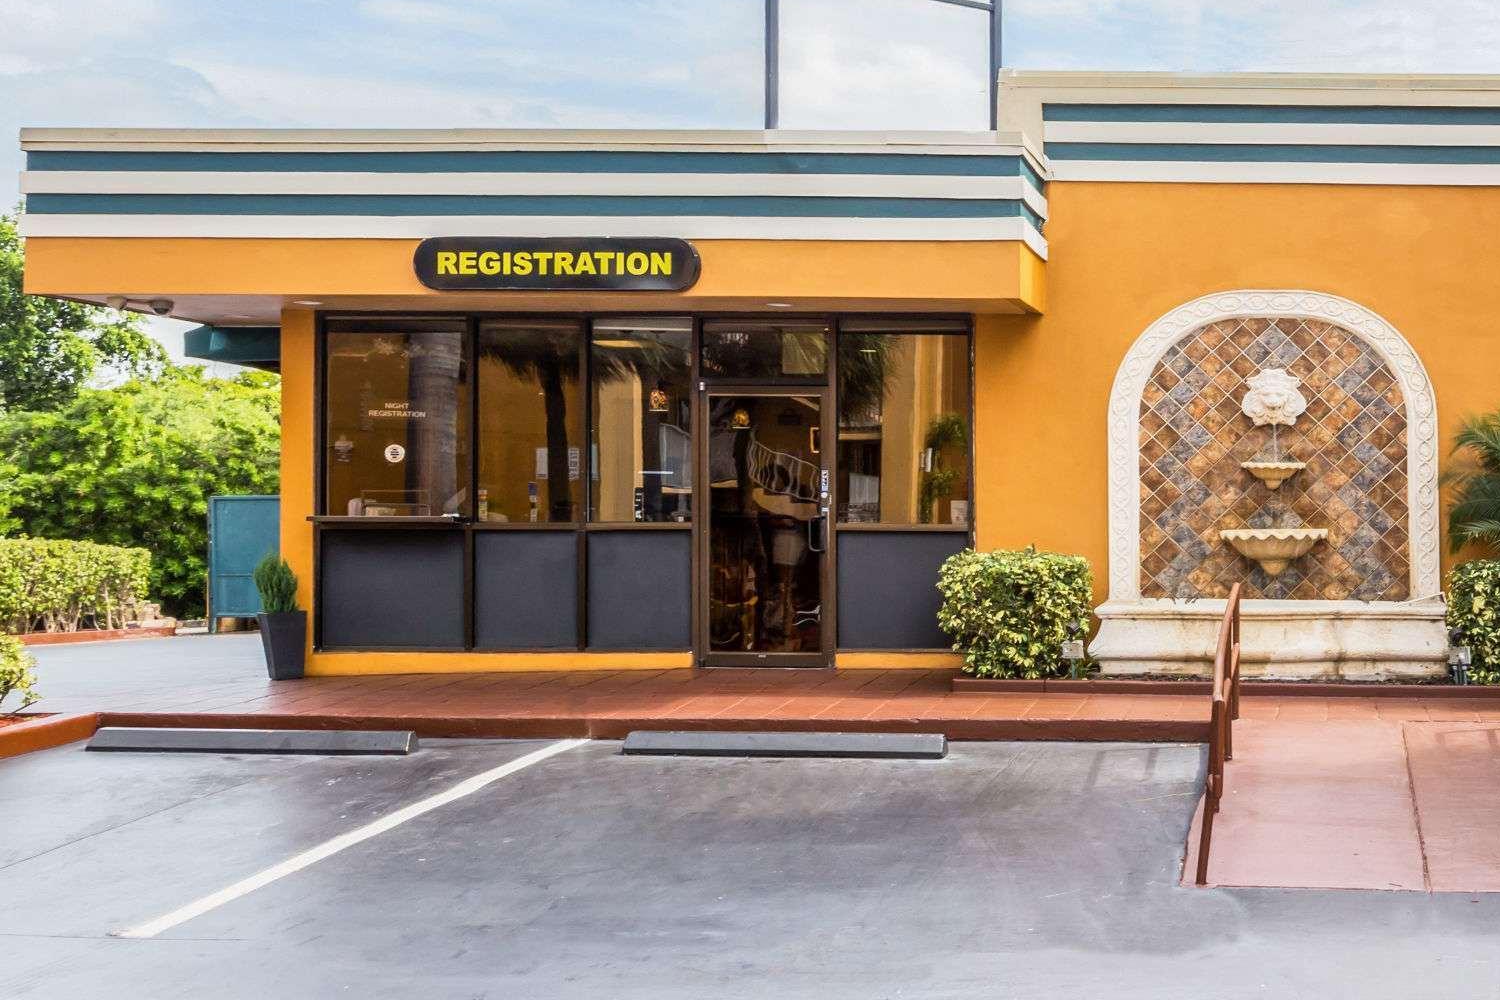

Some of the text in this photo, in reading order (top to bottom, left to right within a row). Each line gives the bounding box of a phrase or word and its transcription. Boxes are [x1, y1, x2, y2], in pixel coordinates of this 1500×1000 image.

[437, 252, 672, 275] REGISTRATION
[384, 402, 410, 410] NIGHT
[368, 409, 426, 418] REGISTRATION
